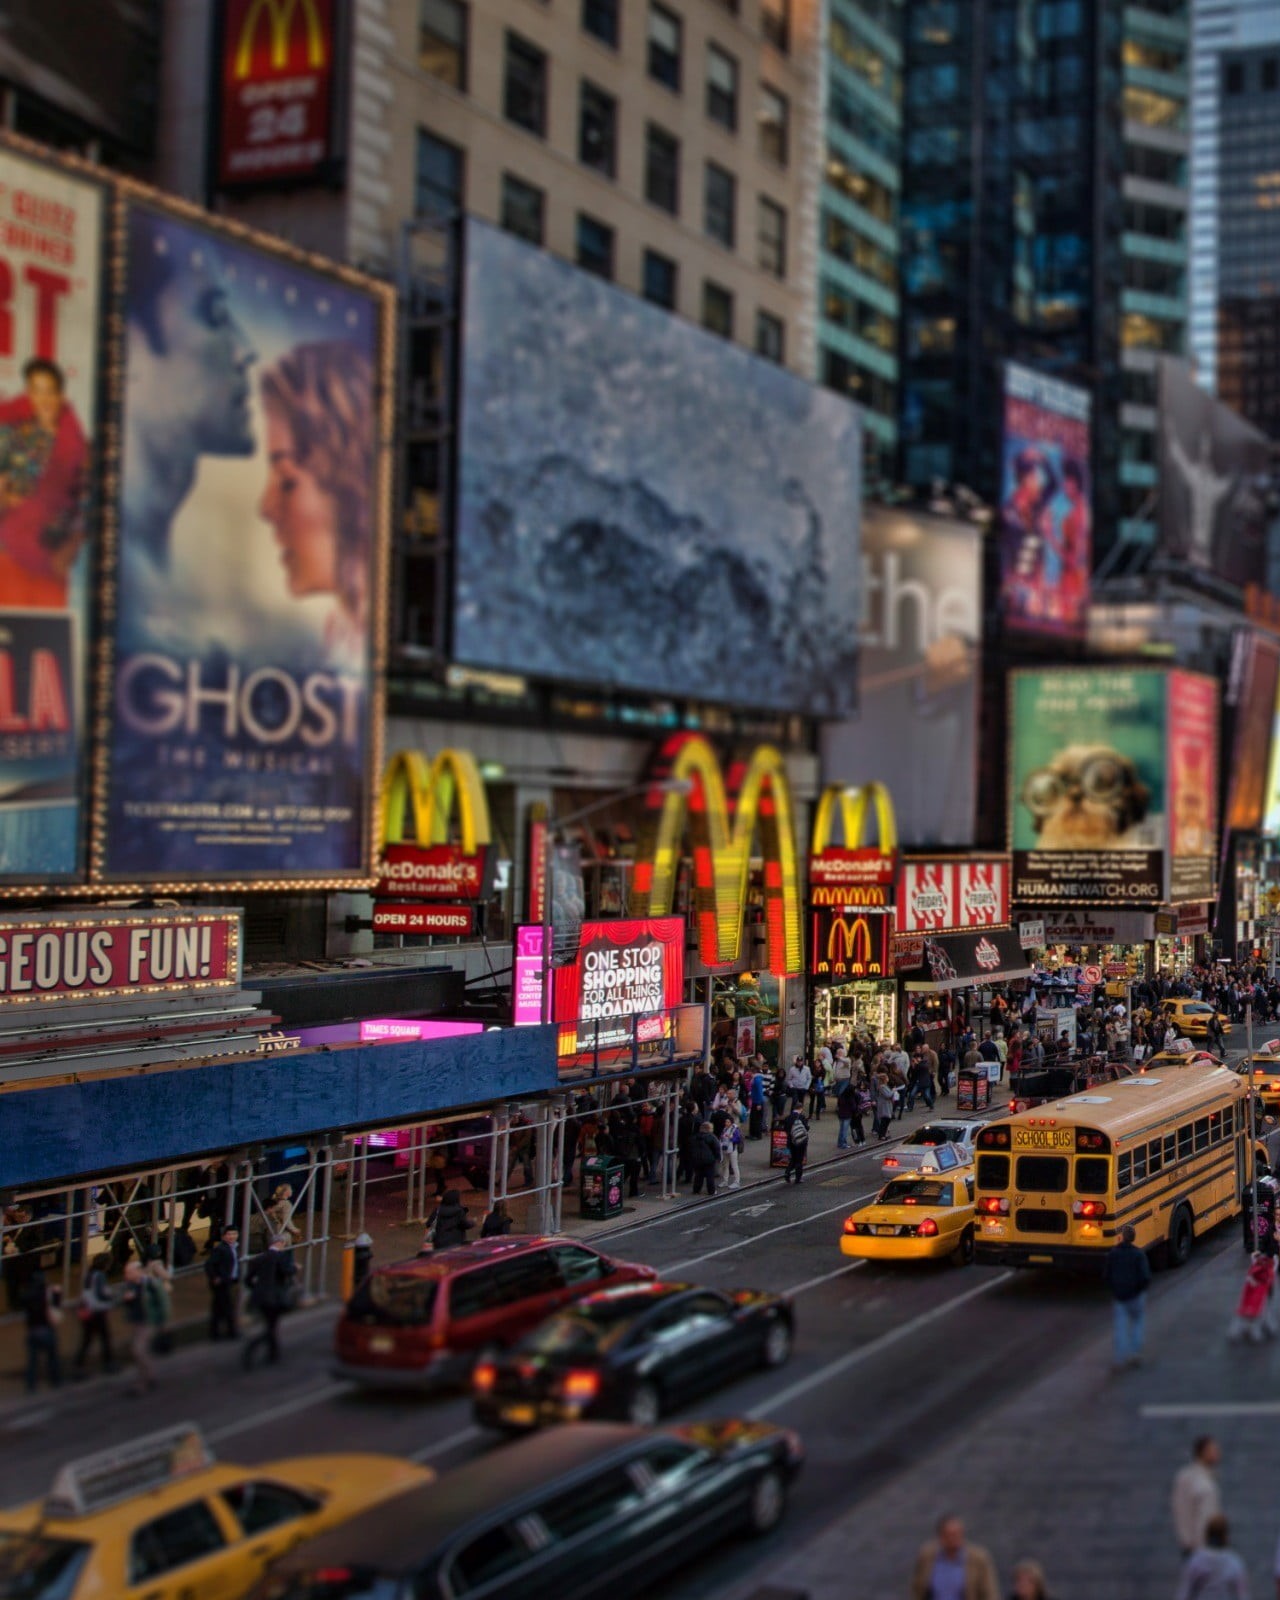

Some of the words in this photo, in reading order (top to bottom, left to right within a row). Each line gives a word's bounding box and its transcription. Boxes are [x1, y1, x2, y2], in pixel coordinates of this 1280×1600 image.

[248, 104, 307, 141] 24
[117, 653, 364, 747] GHOST
[380, 862, 477, 880] McDonald's
[810, 860, 892, 872] McDonald's
[387, 880, 459, 893] Restaurant
[1017, 882, 1159, 897] HUMANEWATCH.ORG
[374, 914, 406, 926] OPEN
[409, 914, 424, 927] 24
[426, 914, 468, 927] HOURS
[1047, 926, 1115, 936] COMPUTERS
[129, 926, 212, 982] FUN!
[585, 951, 620, 971] ONE
[622, 947, 661, 967] STOP
[583, 965, 662, 991] SHOPPING
[584, 989, 605, 1005] FOR
[606, 986, 625, 1002] ALL
[626, 983, 661, 999] THINGS
[581, 995, 663, 1020] BROADWAY
[364, 1023, 389, 1034] TIMES
[390, 1024, 422, 1036] SQUARE
[1016, 1131, 1051, 1146] SCHOOL
[1052, 1132, 1071, 1147] BUS
[1040, 1196, 1047, 1206] 6
